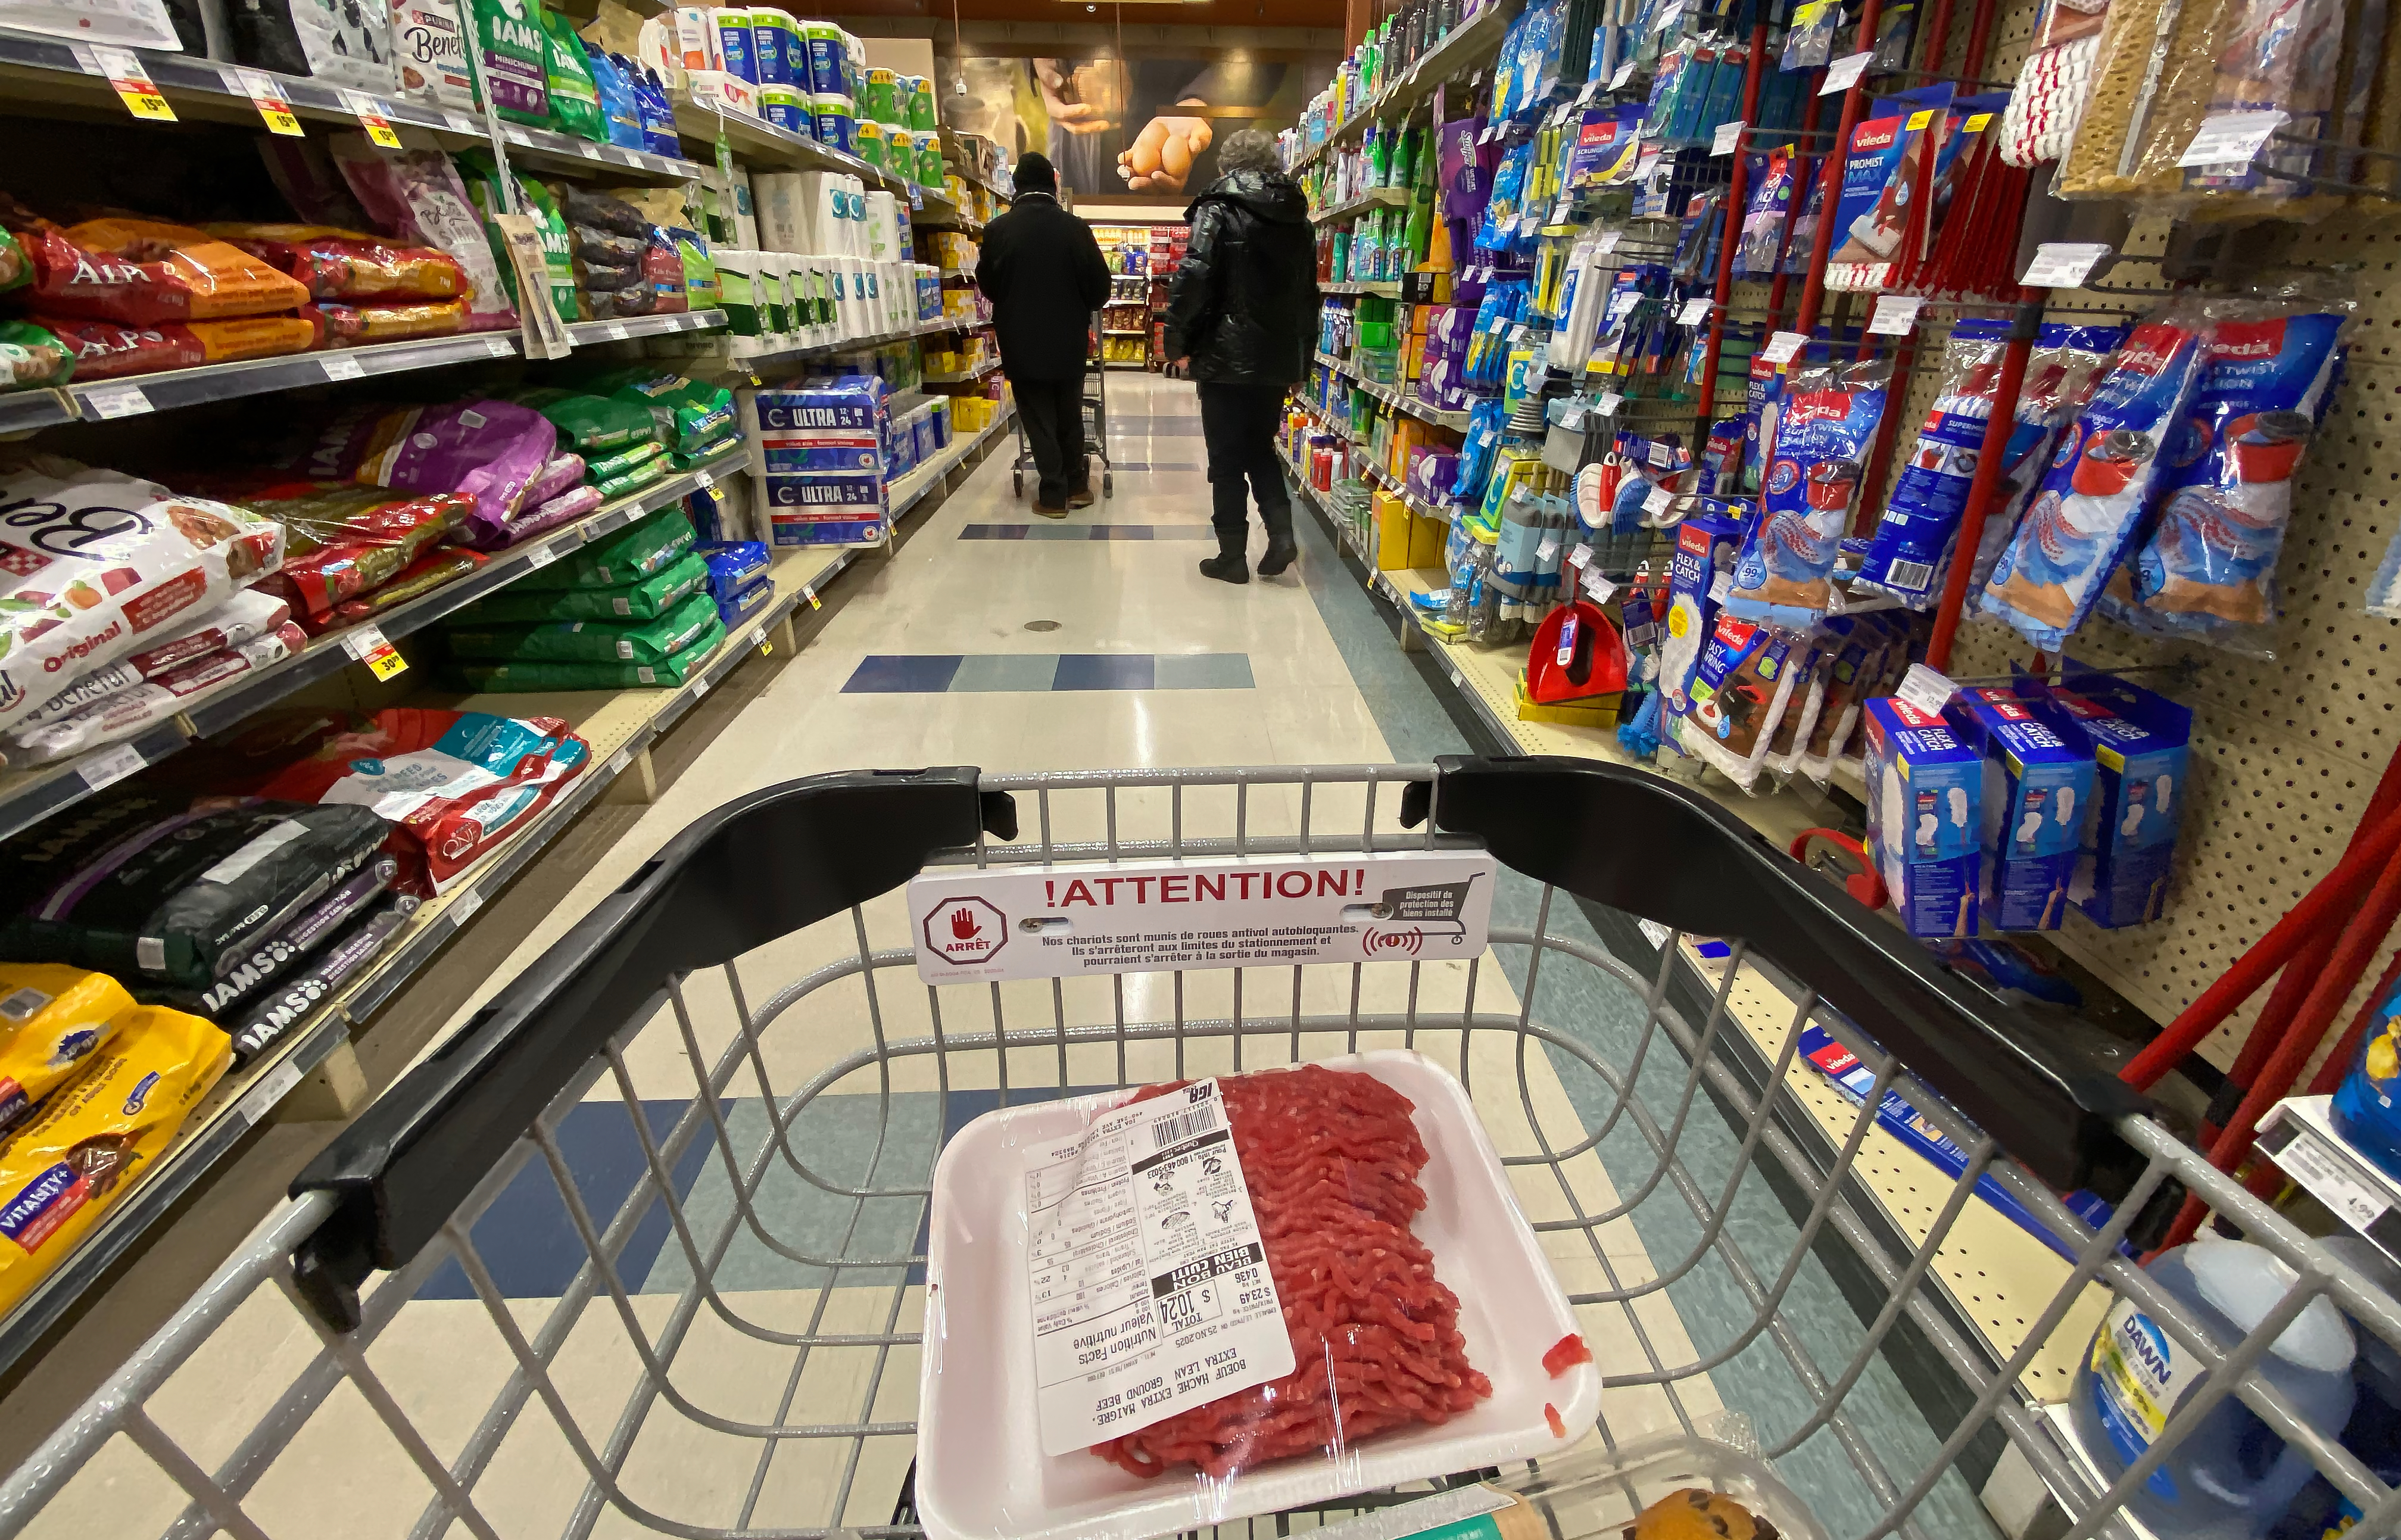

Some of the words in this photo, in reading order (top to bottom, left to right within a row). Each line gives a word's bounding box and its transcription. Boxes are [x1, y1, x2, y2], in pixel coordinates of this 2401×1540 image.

[492, 16, 541, 53] IAMS
[1461, 130, 1474, 167] Swiffer
[1583, 133, 1613, 144] vileda
[1857, 132, 1892, 147] vileda
[1850, 155, 1885, 170] PROMIST
[1748, 389, 1766, 400] CATCH
[1749, 381, 1760, 390] FLEX
[793, 408, 837, 427] ULTRA
[841, 417, 852, 425] 24
[802, 485, 843, 503] ULTRA
[847, 493, 857, 501] 24
[1682, 538, 1705, 554] vileda
[1675, 563, 1701, 584] CATCH
[1676, 553, 1694, 568] FLEX
[1694, 560, 1701, 572] &
[1718, 624, 1745, 646] vileda
[43, 620, 122, 673] Original
[1895, 700, 1922, 725] vileda
[1917, 729, 1944, 751] CATCH
[2019, 722, 2054, 748] CATCH
[1045, 868, 1364, 908] !ATTENTION!
[1405, 890, 1446, 900] Dispositif
[1399, 900, 1439, 910] protection
[1440, 899, 1454, 908] des
[1402, 908, 1423, 918] biens
[1424, 908, 1453, 917] installé
[945, 939, 991, 953] ARRÊT
[1042, 936, 1064, 946] Nos
[1066, 933, 1113, 945] chariots
[1116, 933, 1140, 943] sont
[1143, 931, 1177, 942] munis
[1180, 930, 1194, 940] de
[1197, 930, 1228, 940] roues
[1231, 927, 1269, 938] antivol
[1271, 924, 1359, 937] autobloquantes.
[1071, 946, 1086, 956] Ils
[1088, 943, 1155, 955] s'arrêteront
[1158, 944, 1178, 952] aux
[1180, 941, 1218, 951] limites
[1221, 940, 1236, 949] du
[1238, 937, 1318, 948] stationnement
[1320, 936, 1332, 946] et
[1083, 955, 1142, 968] pourraient
[1145, 953, 1193, 964] s'arrêter
[1195, 951, 1203, 961] à
[1206, 951, 1216, 960] la
[1219, 949, 1251, 960] sortie
[1253, 948, 1268, 959] du
[1271, 947, 1320, 959] magasin.
[202, 952, 276, 1012] IAMS
[241, 993, 310, 1050] IAMS
[1826, 1052, 1856, 1070] vileda
[1186, 1081, 1215, 1105] IGA
[1175, 1155, 1189, 1168] 800
[1211, 1145, 1226, 1157] Pour
[1090, 1225, 1111, 1240] Sodium
[1115, 1215, 1136, 1230] Sodium
[1213, 1243, 1249, 1268] BIEN
[1215, 1252, 1252, 1277] BEAU
[1040, 1273, 1051, 1285] 22
[1170, 1257, 1209, 1283] CUIT!
[1173, 1267, 1211, 1291] BON
[1159, 1289, 1195, 1324] 10.24
[1200, 1287, 1211, 1304] $
[1118, 1309, 1153, 1336] Valeur
[1171, 1310, 1202, 1332] TOTAL
[1072, 1322, 1118, 1354] nutritive
[1109, 1326, 1156, 1356] Nutrition
[1077, 1344, 1107, 1369] Facts
[1204, 1346, 1237, 1368] EXTRA
[2123, 1314, 2172, 1385] DAWN
[1174, 1360, 1200, 1380] LEAN
[1214, 1357, 1246, 1380] BOEUF
[1125, 1375, 1164, 1400] GROUND
[1177, 1372, 1209, 1395] HACHE
[1095, 1392, 1121, 1412] BEEF
[1140, 1386, 1172, 1408] EXTRA
[1092, 1401, 1135, 1428] MAIGRE.
